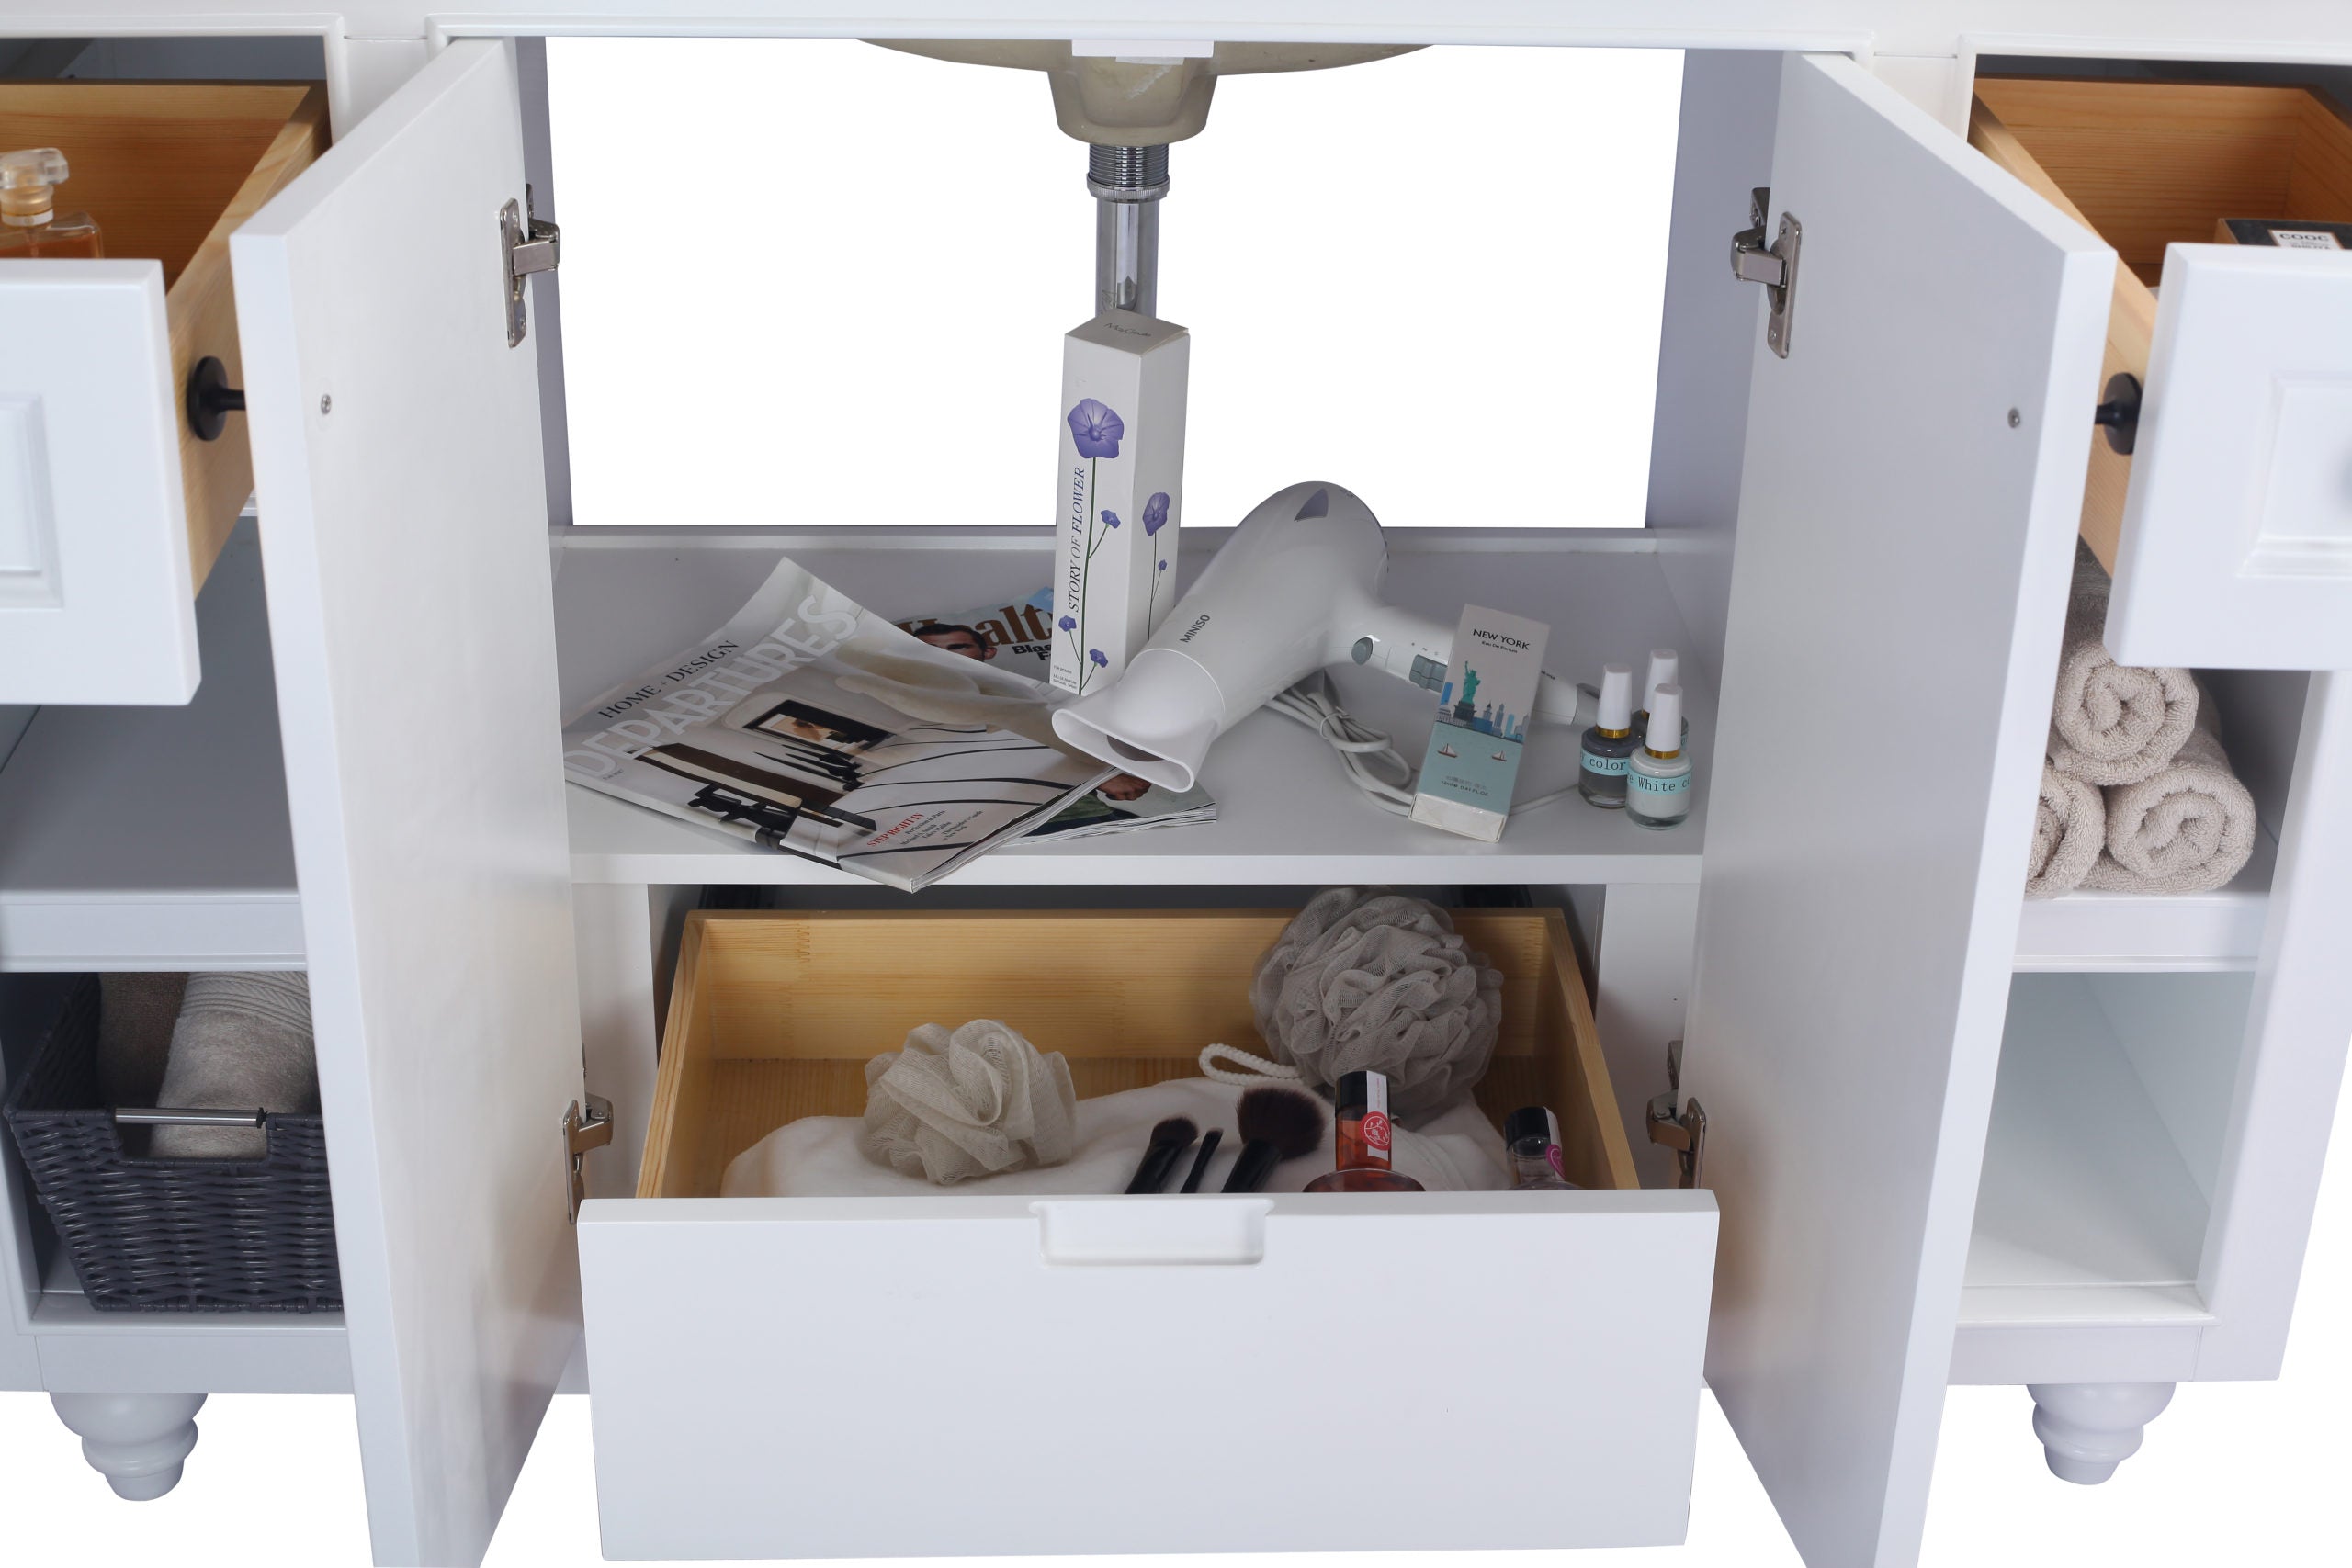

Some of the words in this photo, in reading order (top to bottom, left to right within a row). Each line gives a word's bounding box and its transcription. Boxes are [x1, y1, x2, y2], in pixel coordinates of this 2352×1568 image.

[1072, 467, 1085, 535] FLOWER
[1070, 535, 1081, 559] OF
[1069, 559, 1080, 613] STORY
[1179, 615, 1210, 643] MINISO
[1473, 629, 1498, 640] NEW
[1501, 635, 1530, 650] YORK
[563, 594, 858, 778] DEPARTURES
[598, 685, 662, 718] HOME
[665, 640, 739, 682] DESIGN
[1589, 758, 1626, 771] color
[1638, 776, 1676, 792] White
[866, 833, 890, 846] STEP
[887, 818, 915, 836] RIGHT
